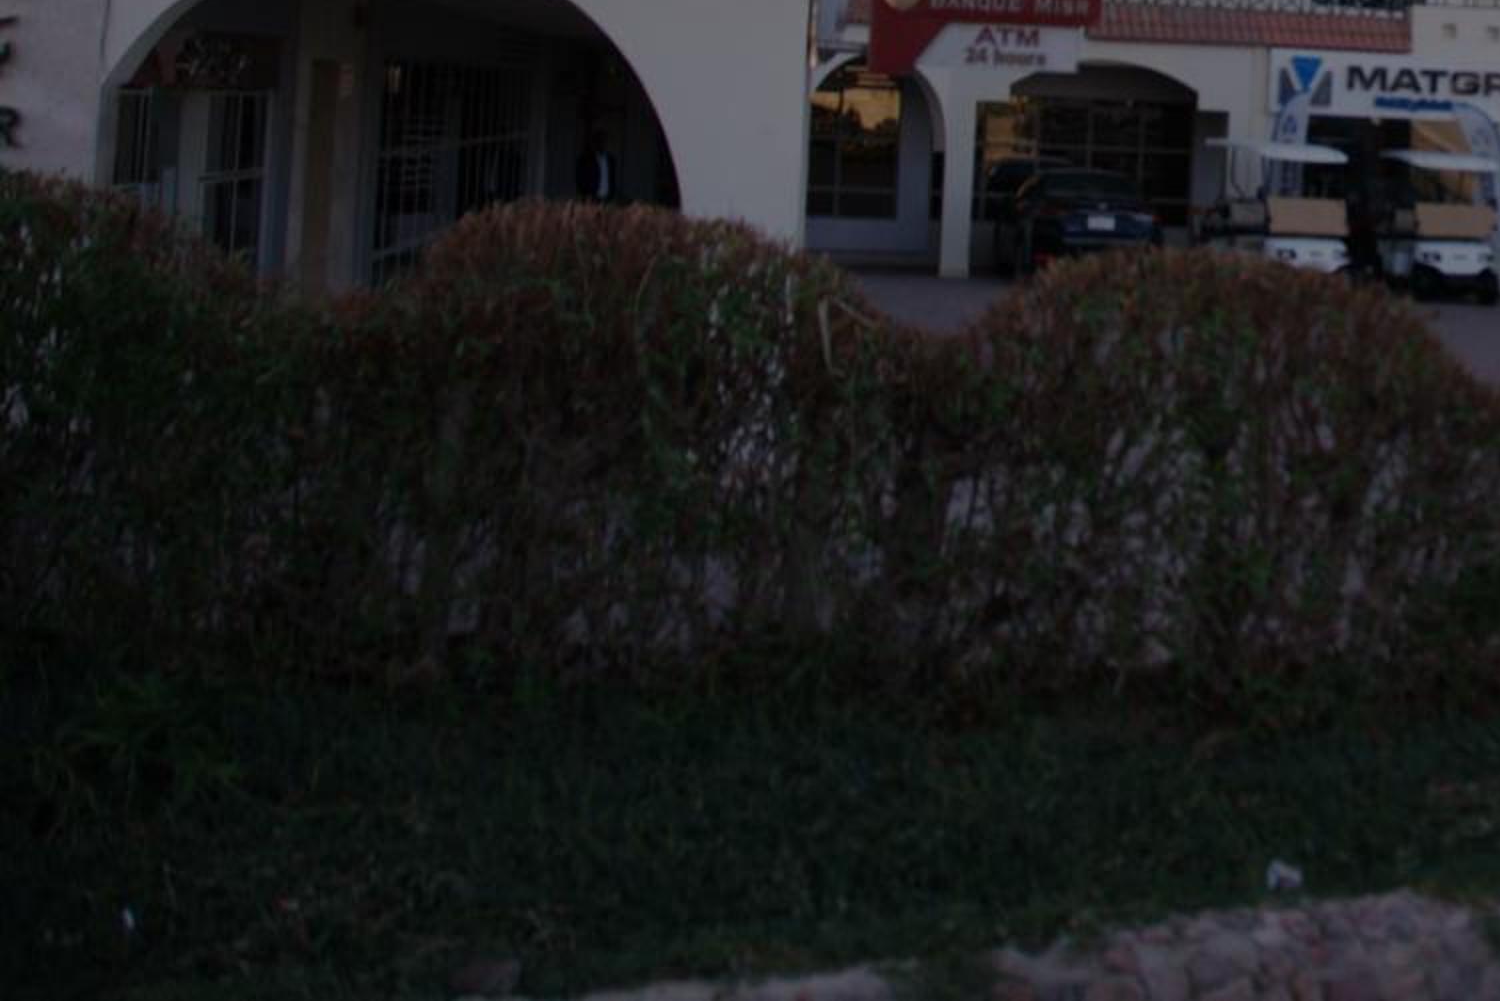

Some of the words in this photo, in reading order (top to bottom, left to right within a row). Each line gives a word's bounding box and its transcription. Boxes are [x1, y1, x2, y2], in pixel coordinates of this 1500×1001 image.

[974, 25, 1040, 48] ATM
[964, 47, 988, 64] 24
[994, 49, 1047, 67] hours
